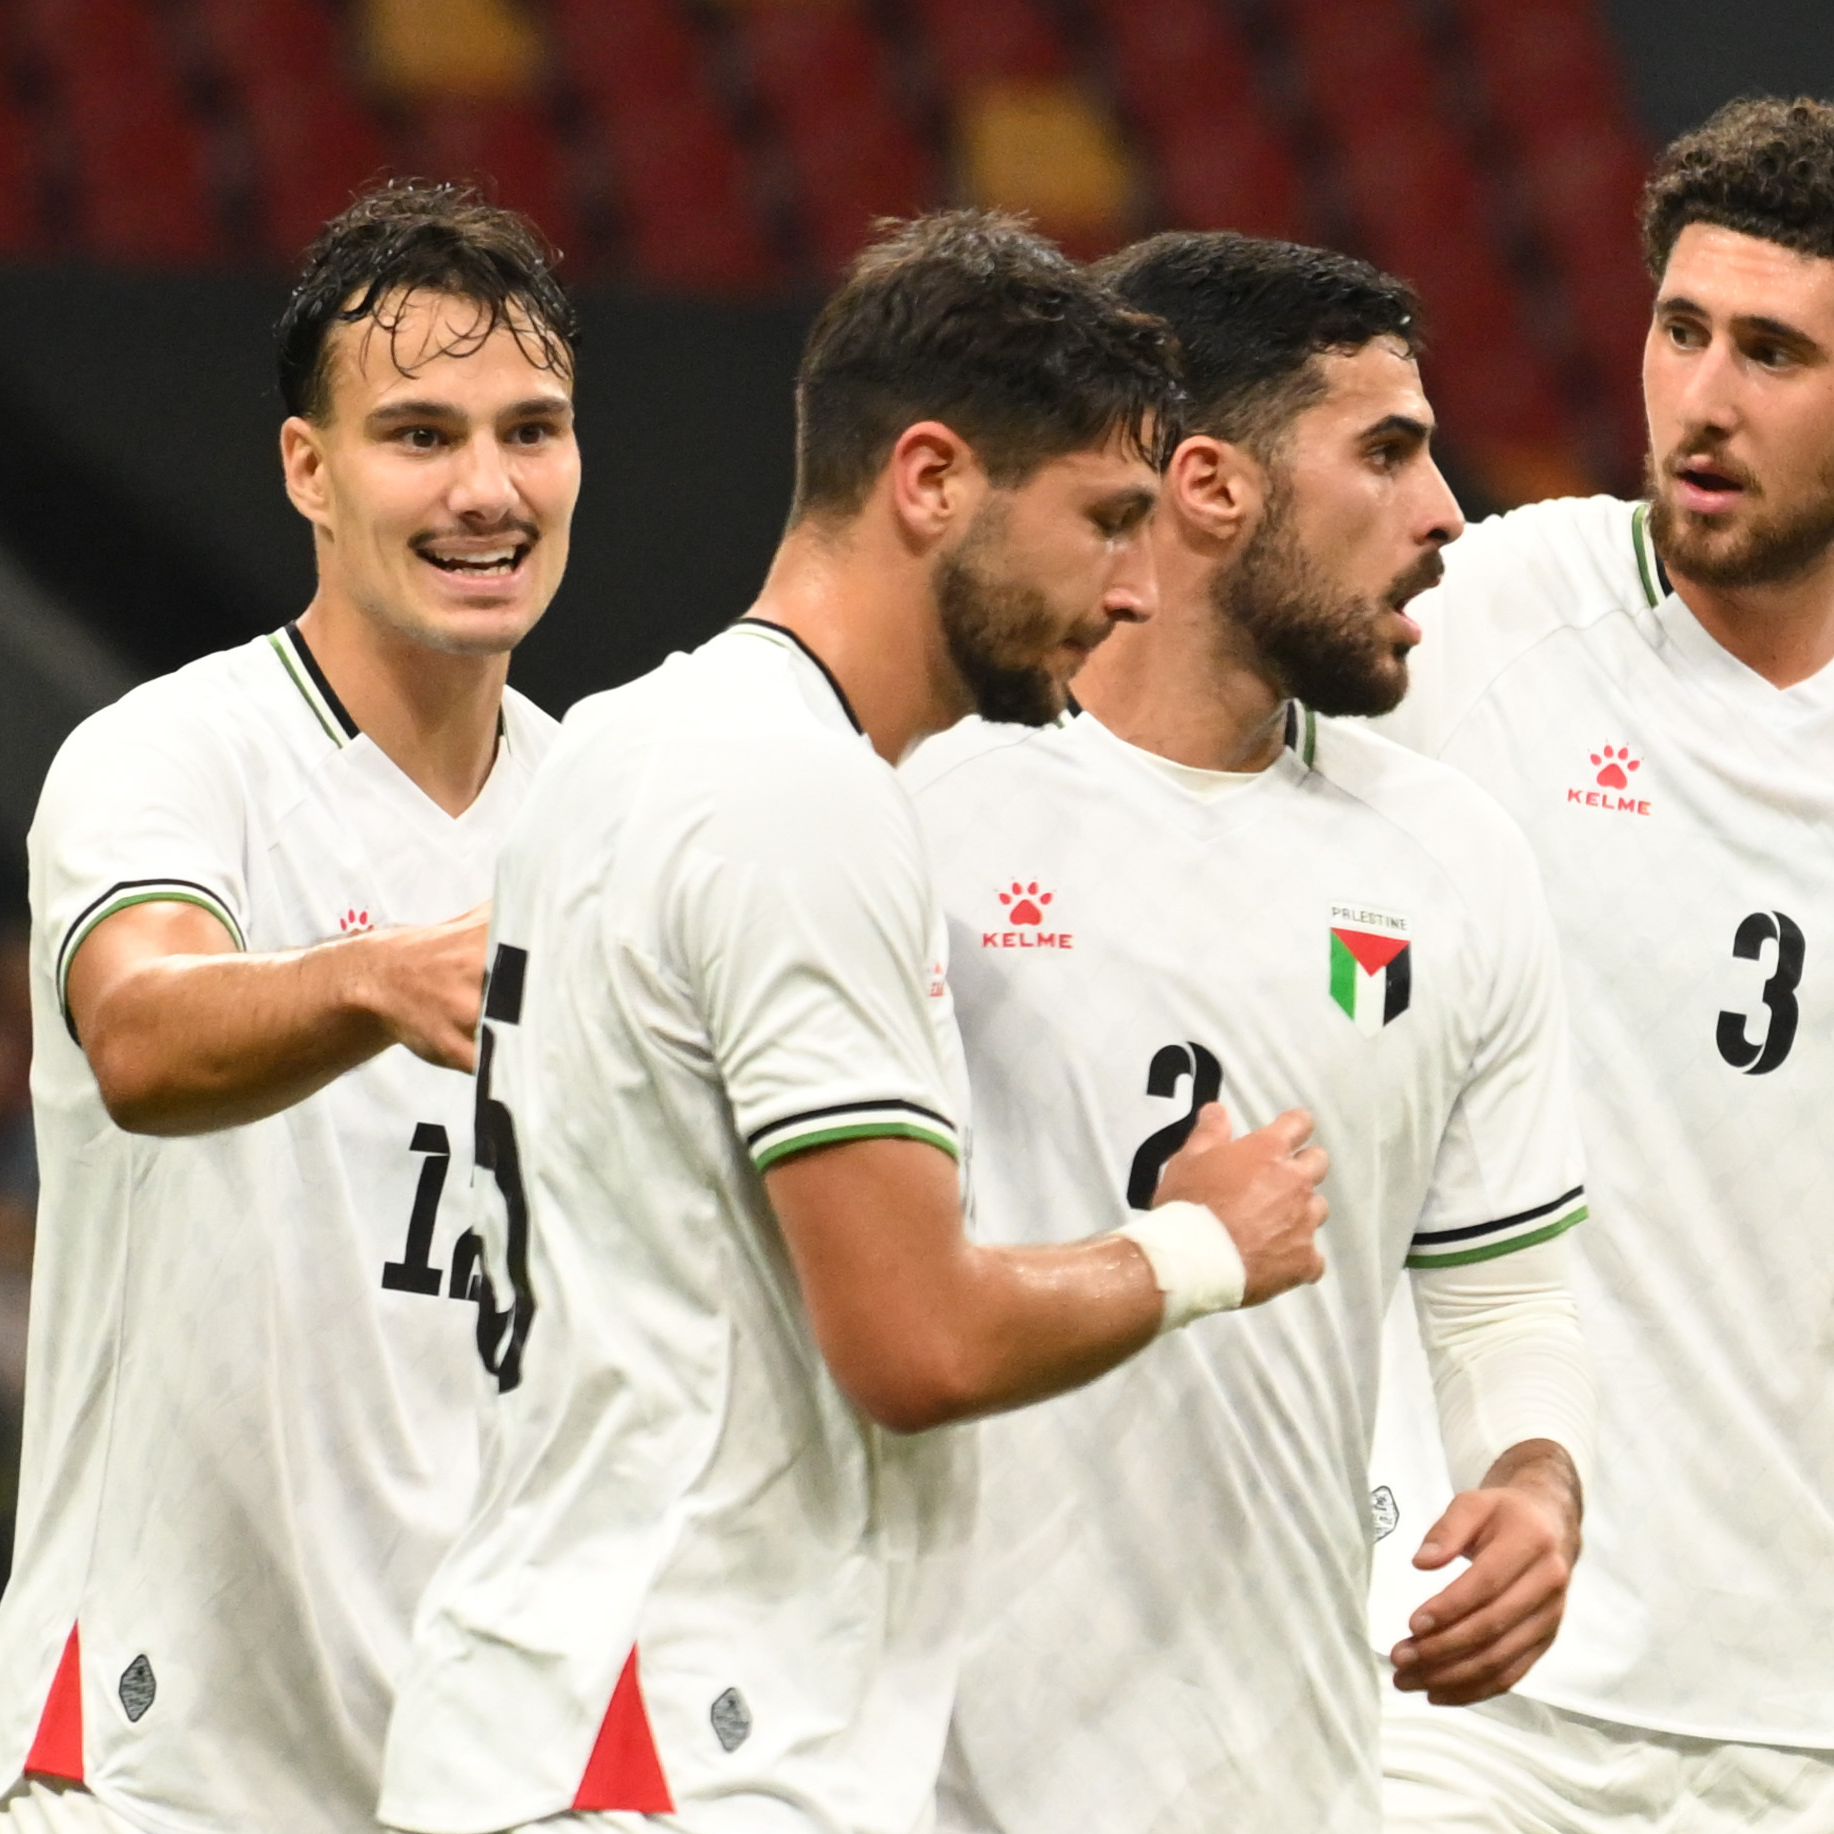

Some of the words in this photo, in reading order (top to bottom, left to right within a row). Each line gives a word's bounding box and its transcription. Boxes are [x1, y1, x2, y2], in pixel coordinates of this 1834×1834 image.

[1567, 788, 1652, 816] KELME
[1331, 906, 1408, 931] PALESTINE
[982, 932, 1073, 950] KELME
[1716, 910, 1806, 1075] 3
[1126, 1041, 1223, 1211] 2
